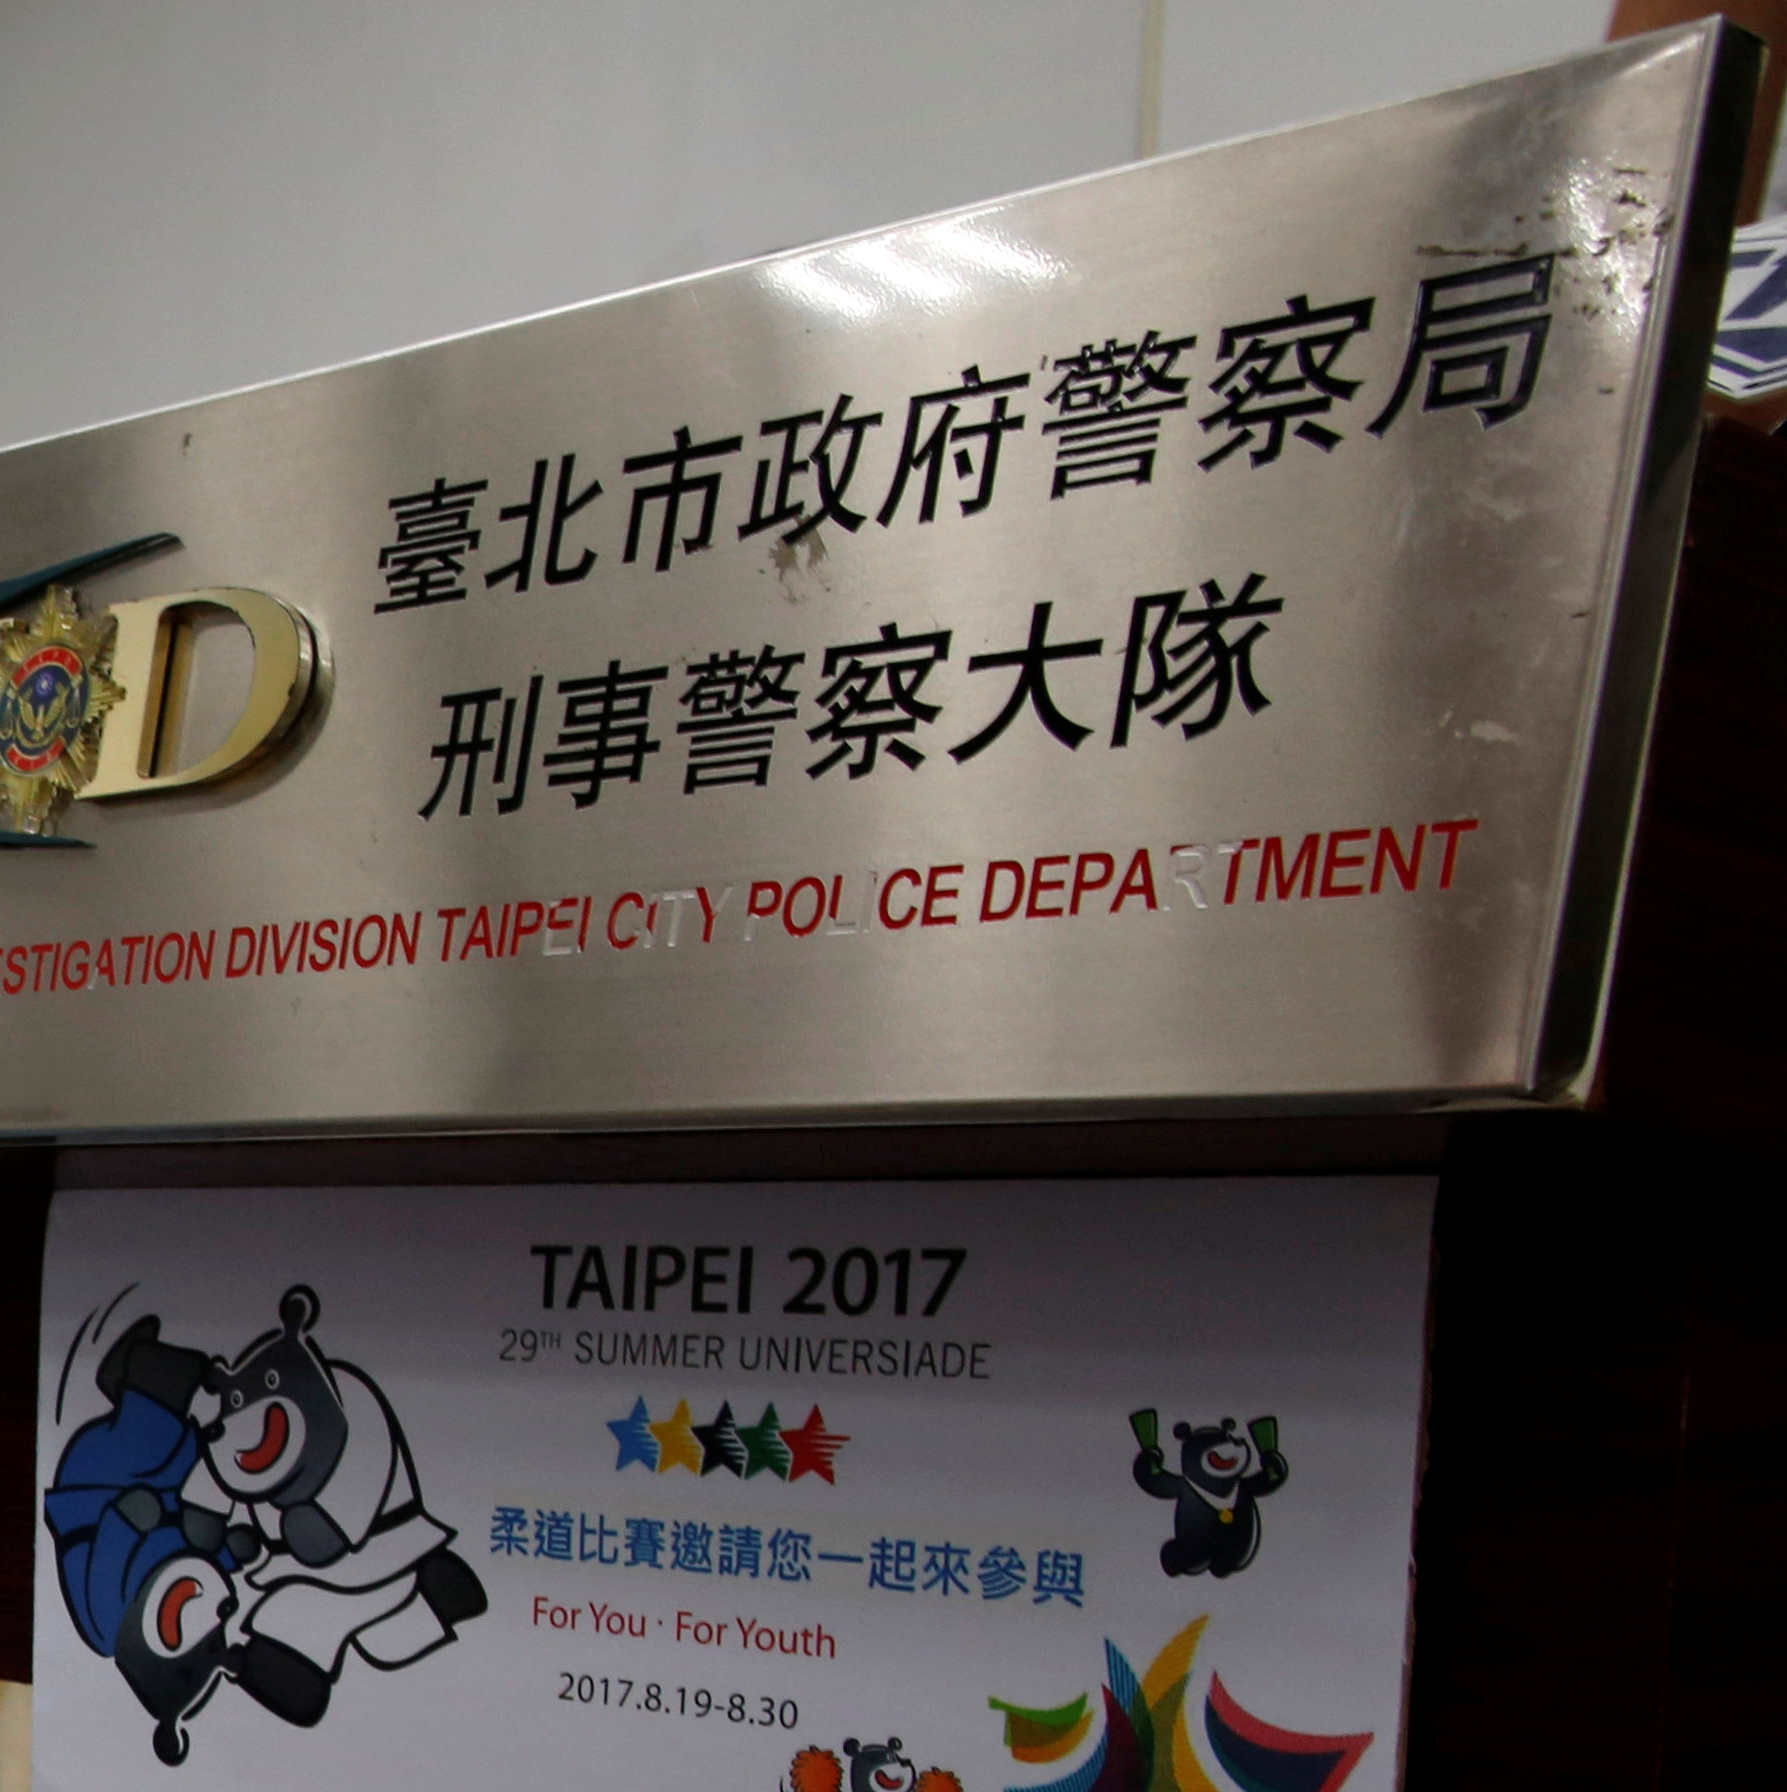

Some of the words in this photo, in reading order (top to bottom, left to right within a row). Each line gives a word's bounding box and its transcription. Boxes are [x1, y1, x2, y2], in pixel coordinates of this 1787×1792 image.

[372, 254, 1555, 616] 臺北市政府警察局
[418, 571, 1284, 821] 刑事警察大隊
[225, 910, 422, 981] DIVISION
[435, 895, 590, 964] TAIPEI
[745, 864, 963, 944] POLICE
[979, 820, 1478, 925] DEPARTMENT
[530, 1245, 755, 1316] TAIPEI
[783, 1247, 969, 1320] 2017
[498, 1327, 564, 1370] 29TH
[574, 1331, 728, 1374] SUMMER
[738, 1335, 992, 1382] UNIVERSIADE
[489, 1504, 1087, 1608] 柔道比賽邀請您一起來參與
[532, 1596, 587, 1634] For
[590, 1600, 649, 1640] You
[675, 1609, 729, 1648] For
[734, 1613, 839, 1660] Youth
[558, 1672, 801, 1733] 2017.8.19-8.30
